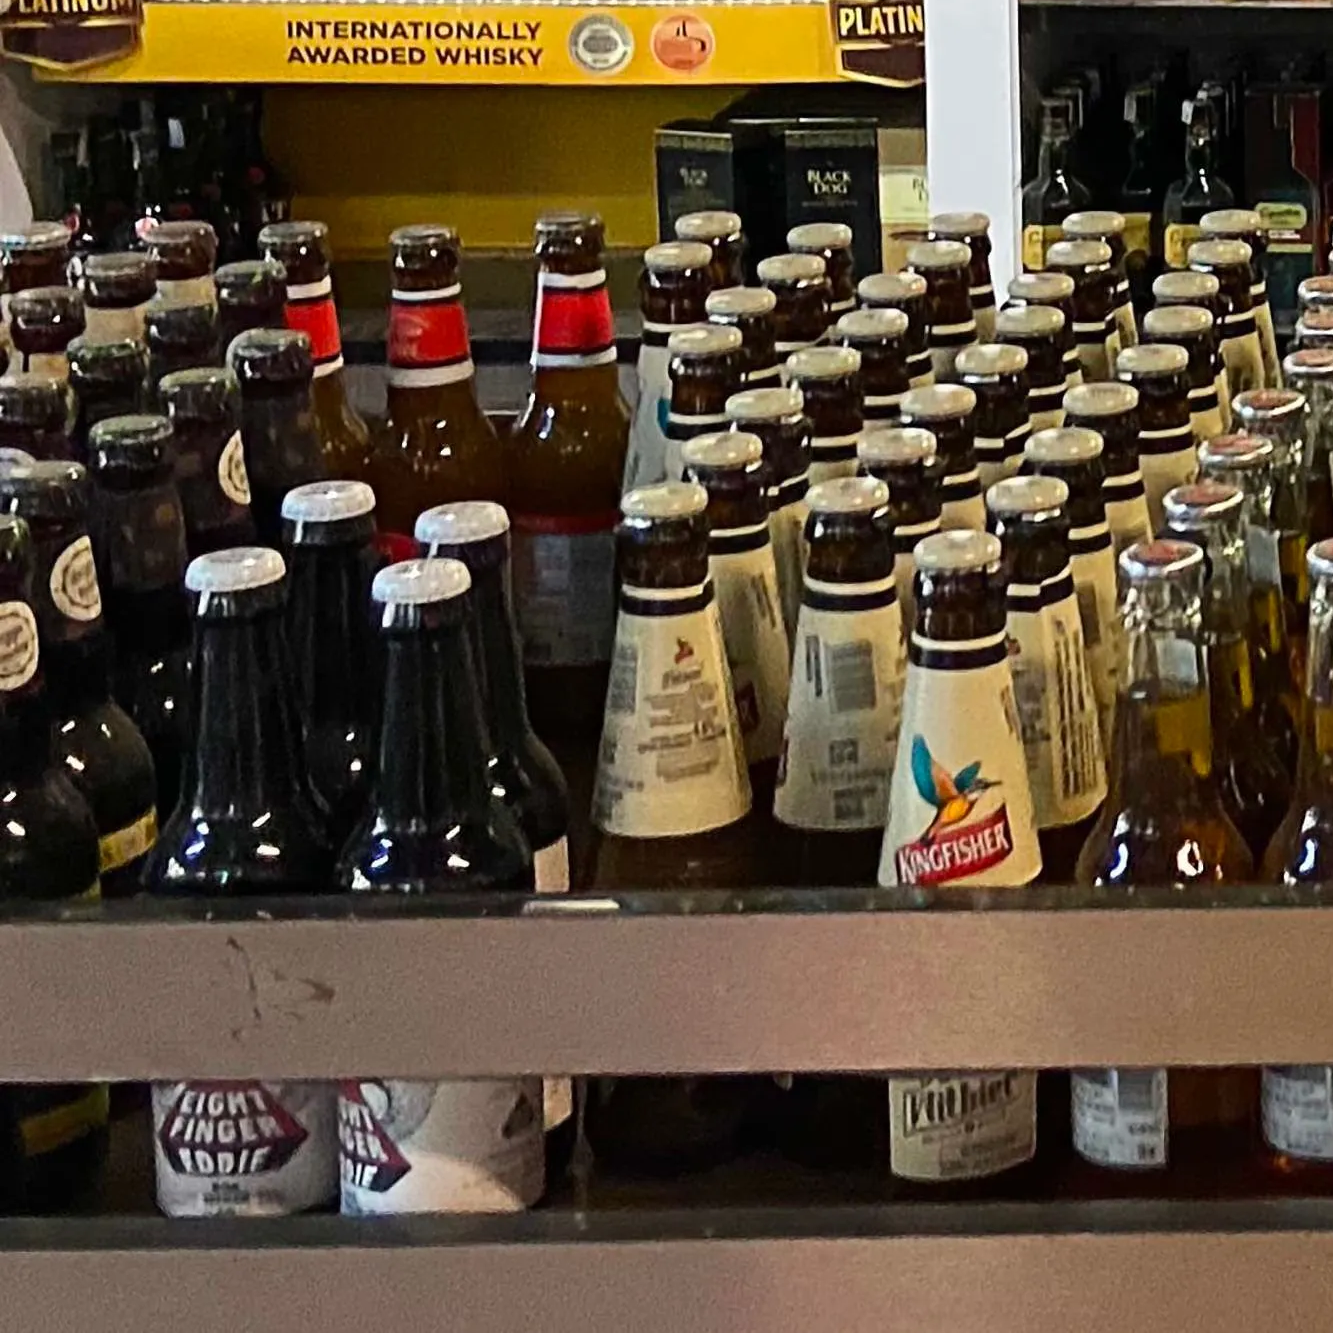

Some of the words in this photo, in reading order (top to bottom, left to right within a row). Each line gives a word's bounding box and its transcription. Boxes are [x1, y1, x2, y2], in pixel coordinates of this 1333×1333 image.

[287, 20, 541, 41] INTERNATIONALLY
[839, 5, 923, 36] PLATIN
[287, 46, 426, 65] AWARDED
[434, 47, 543, 66] WHISKY
[807, 169, 851, 184] BLACK
[813, 183, 848, 195] DOG
[898, 817, 1010, 884] KINGFISHER
[179, 1089, 267, 1116] EIGHT
[169, 1117, 285, 1144] FINGER
